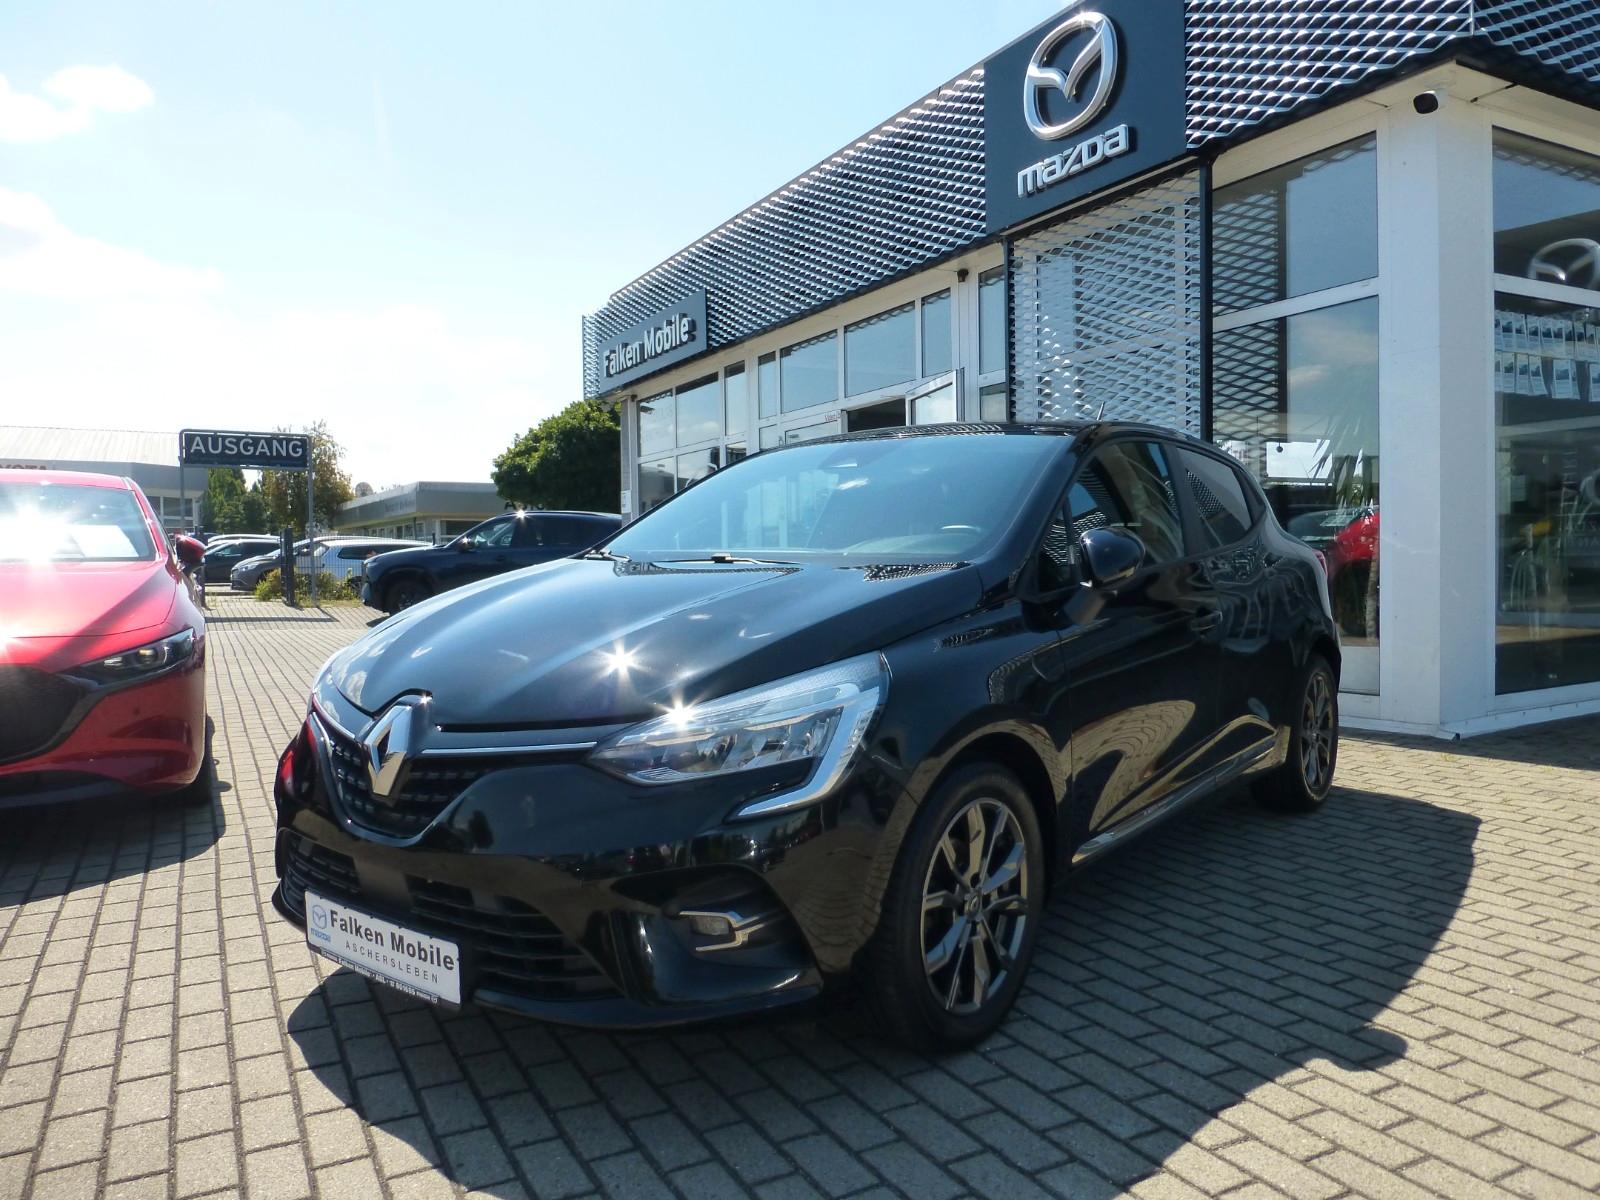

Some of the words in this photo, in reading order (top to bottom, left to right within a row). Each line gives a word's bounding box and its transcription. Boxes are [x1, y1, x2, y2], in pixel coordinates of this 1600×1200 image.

[1017, 124, 1129, 199] mazda
[602, 341, 641, 378] Falken
[644, 313, 693, 360] Mobile
[190, 435, 303, 457] AUSGANG
[330, 909, 384, 947] Falken
[390, 931, 455, 971] Mobile
[345, 939, 439, 985] ASCHERSLEBEN
